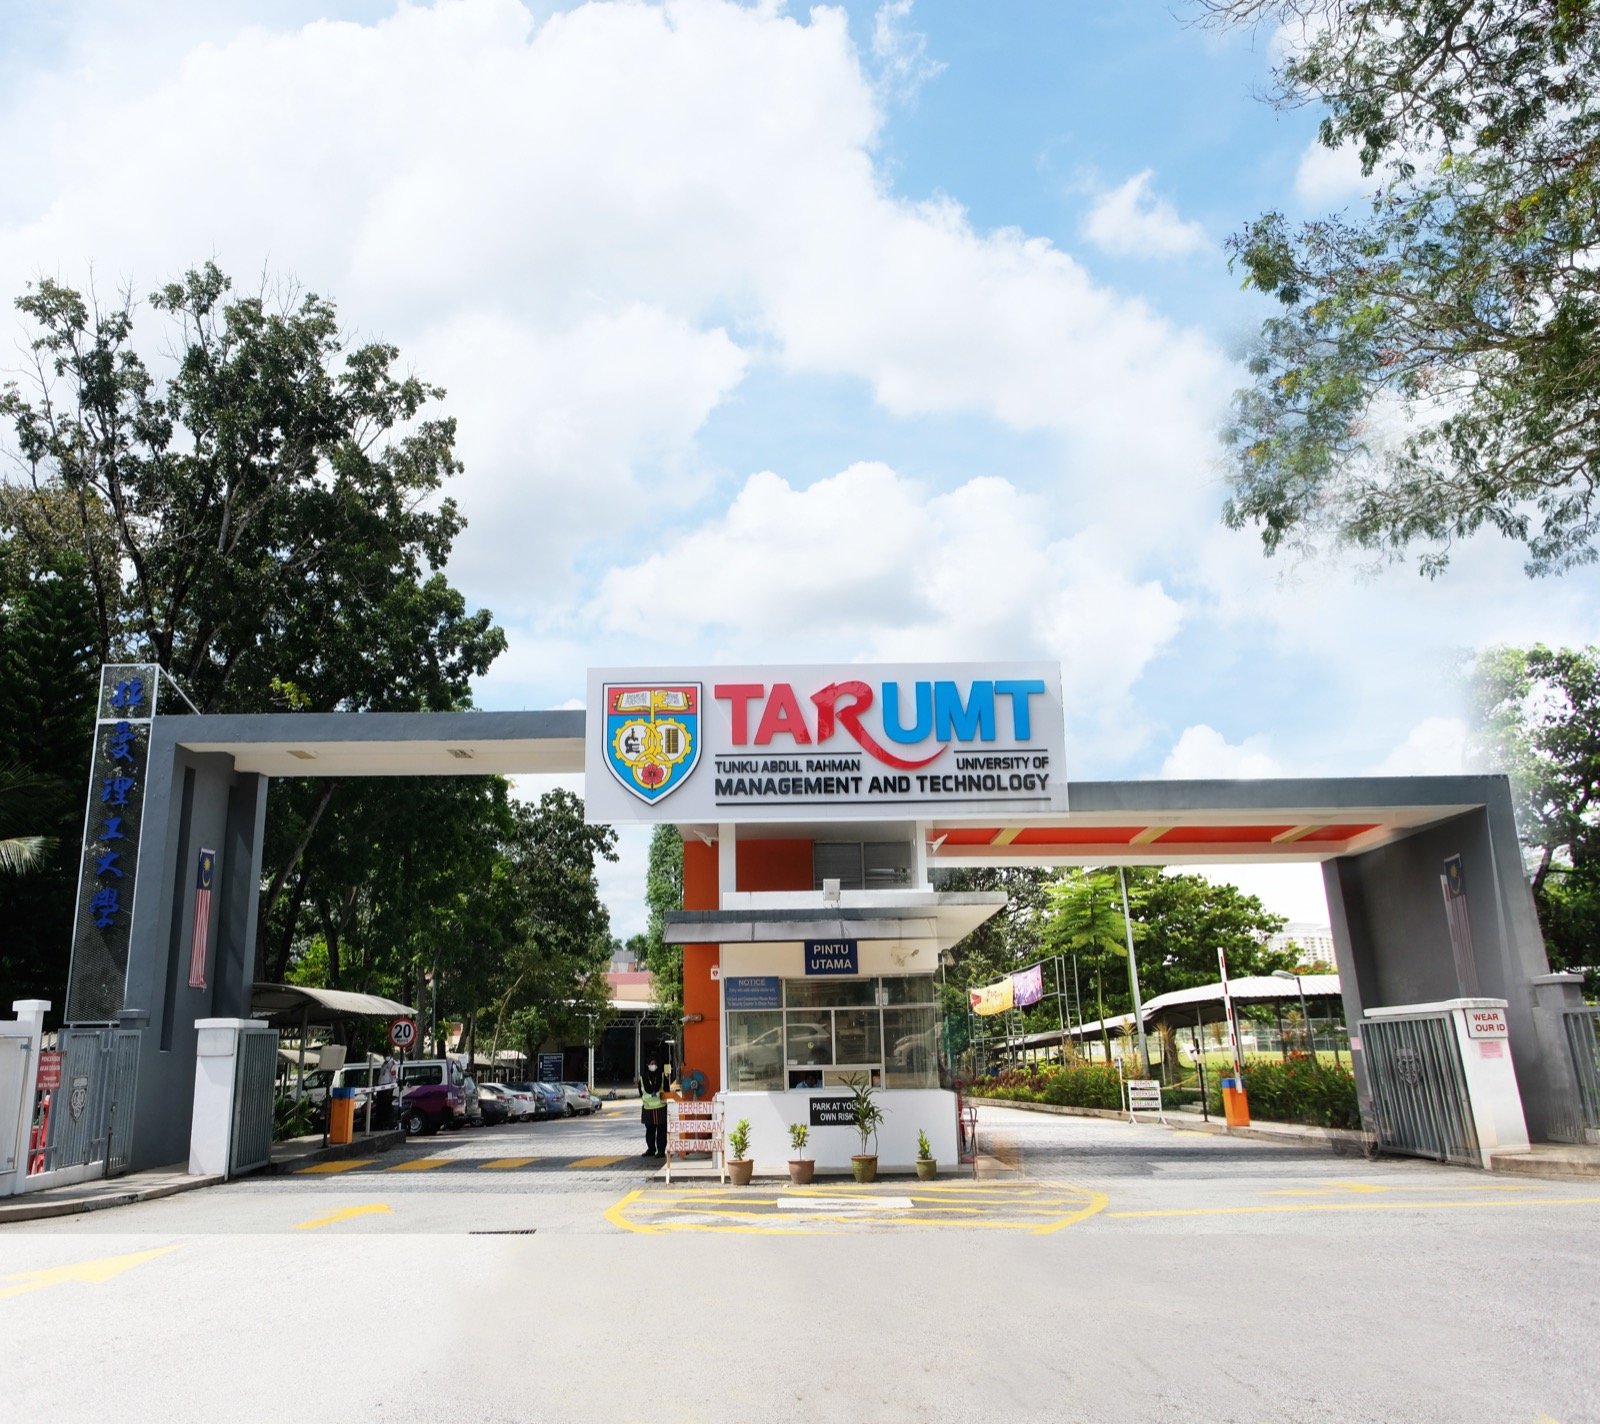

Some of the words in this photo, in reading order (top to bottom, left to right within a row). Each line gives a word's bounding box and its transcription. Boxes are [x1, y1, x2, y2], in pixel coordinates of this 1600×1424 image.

[714, 761, 758, 774] TUNKU
[761, 761, 803, 773] ABDUL
[806, 759, 861, 773] RAHMAN
[956, 757, 1030, 770] UNIVERSITY
[1032, 756, 1049, 769] OF
[714, 776, 862, 796] MANAGEMENT
[868, 776, 911, 793] AND
[916, 774, 1049, 793] TECHNOLOGY
[813, 944, 849, 955] PINTU
[811, 959, 852, 970] UTAMA
[1472, 1013, 1499, 1021] WEAR
[394, 1024, 411, 1039] 20
[1475, 1023, 1495, 1032] OUR
[1496, 1023, 1506, 1031] ID
[679, 1102, 714, 1114] BERHENTI
[812, 1102, 831, 1111] PARK
[831, 1102, 841, 1111] AT
[820, 1113, 837, 1121] OWN
[838, 1113, 854, 1121] RISK
[669, 1121, 722, 1132] PEMERIKSAAN
[669, 1140, 723, 1152] KESELAMATAN
